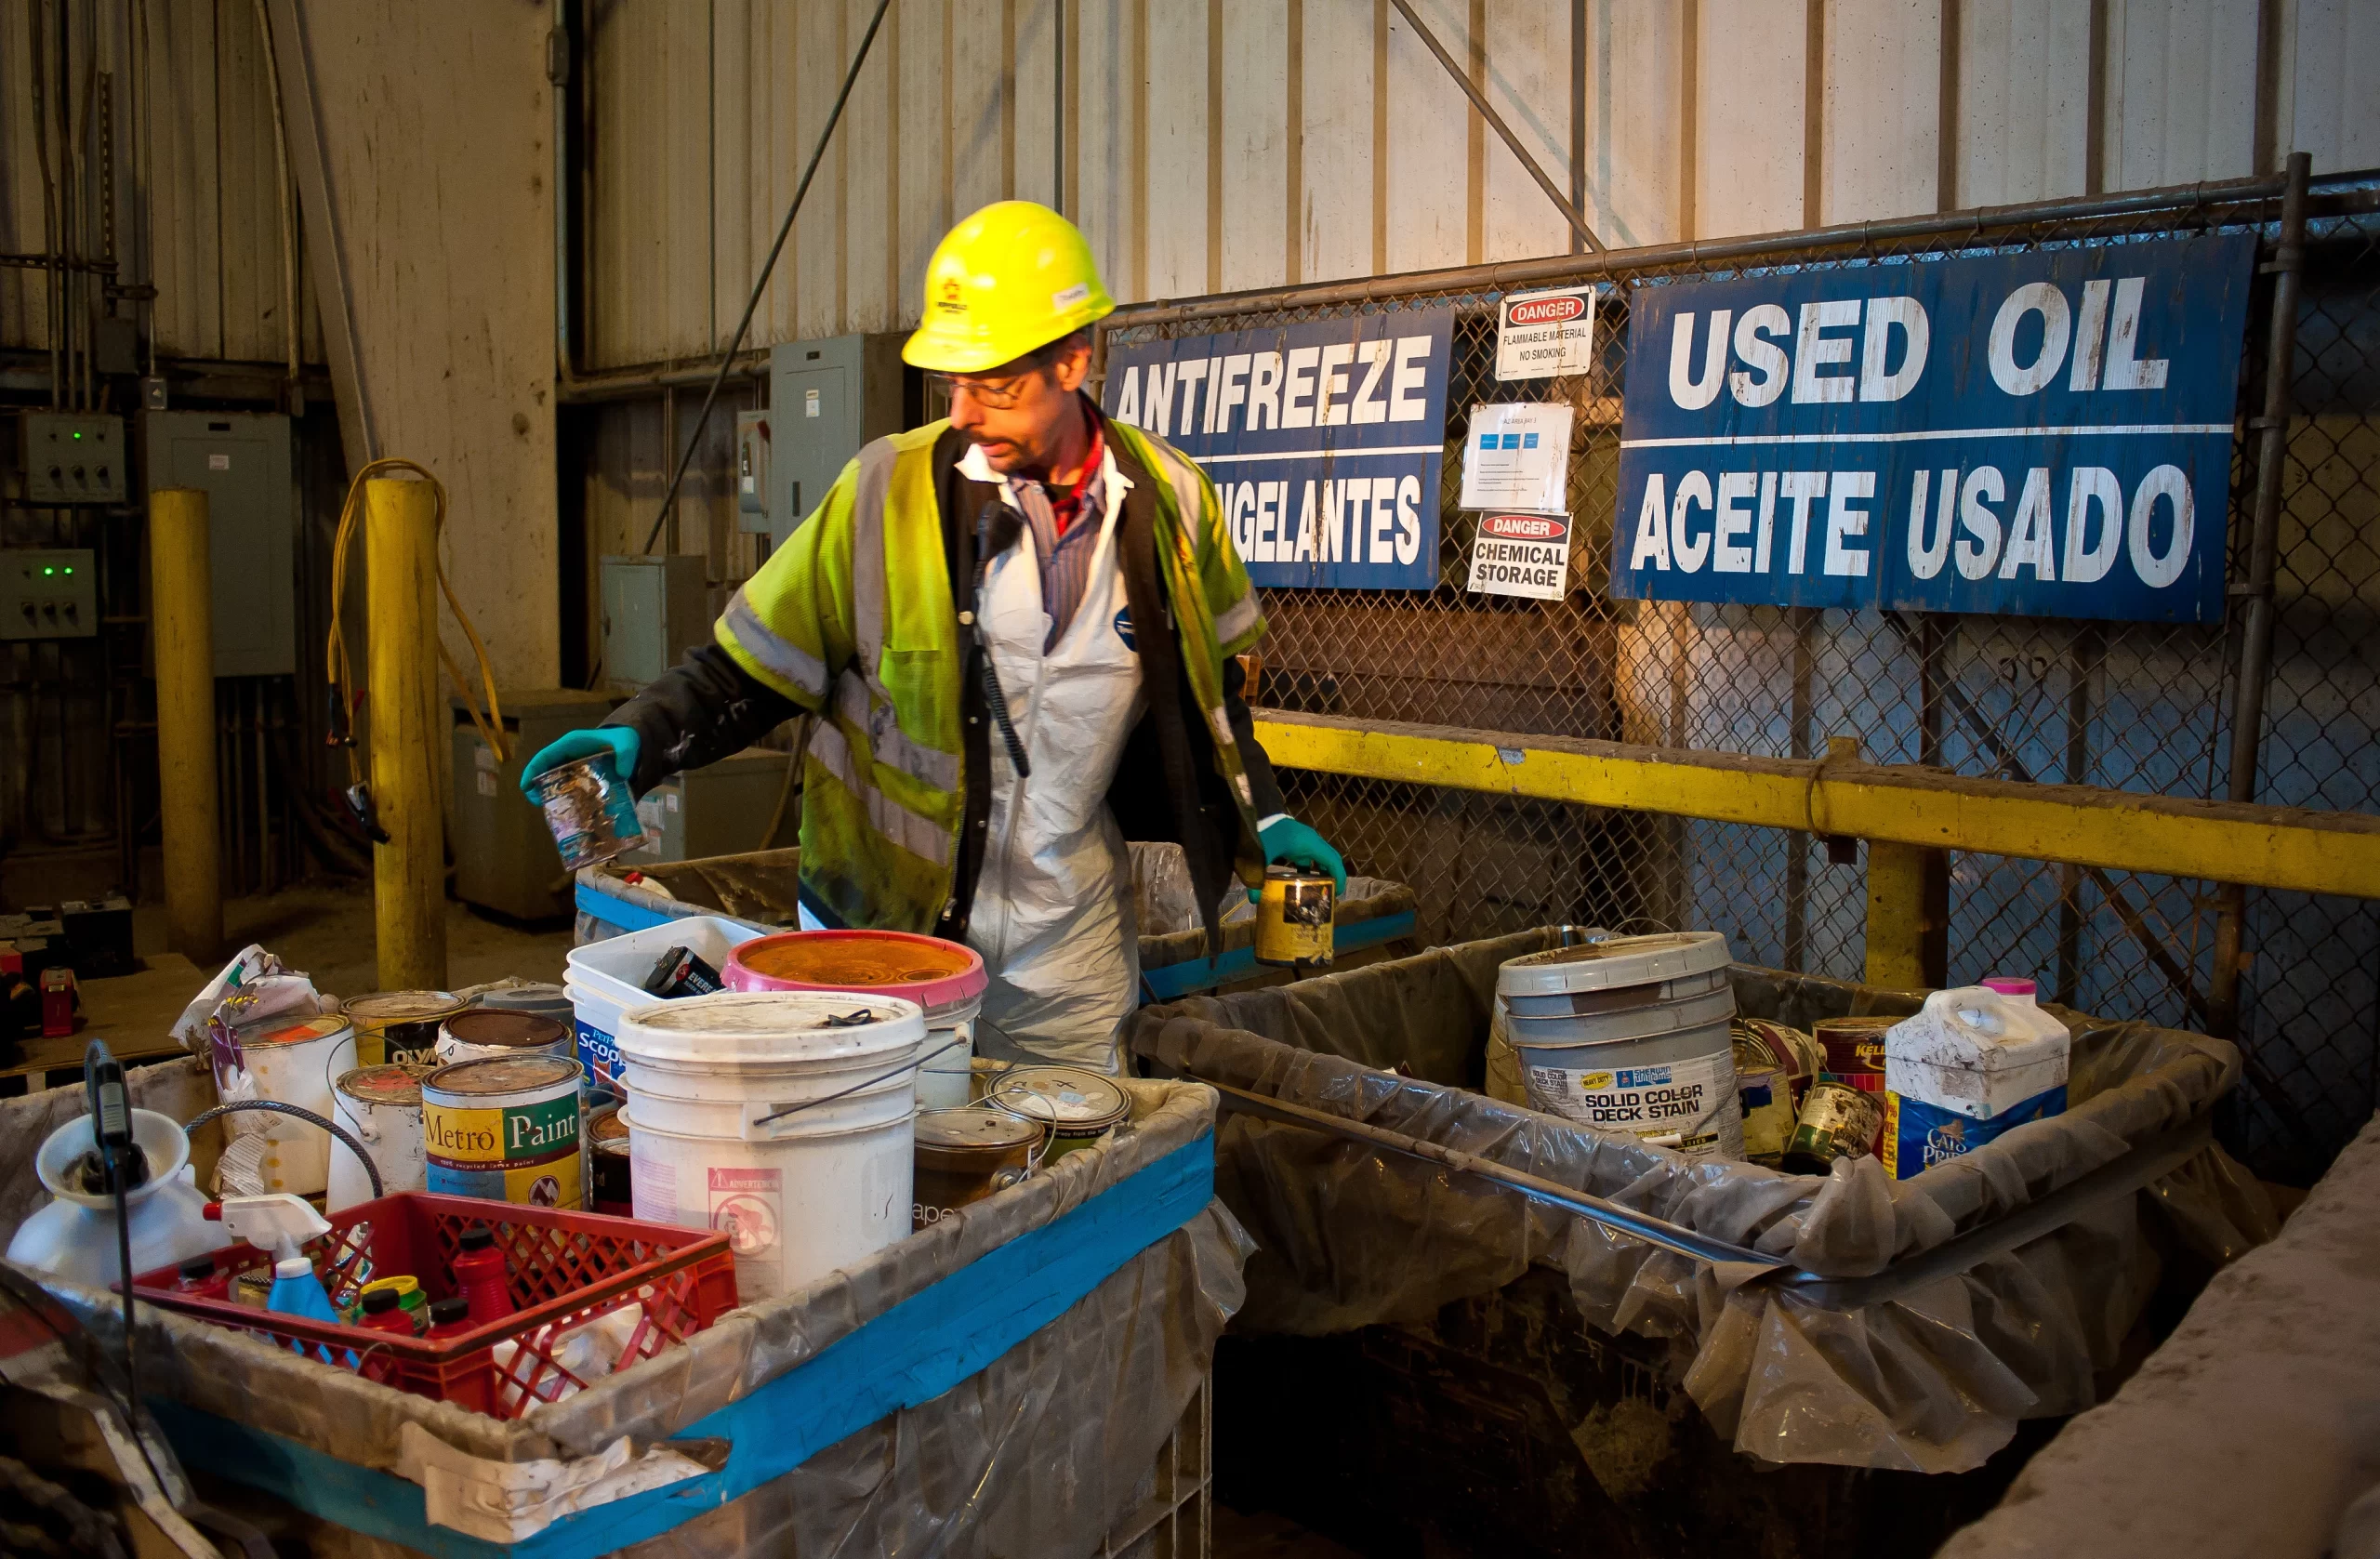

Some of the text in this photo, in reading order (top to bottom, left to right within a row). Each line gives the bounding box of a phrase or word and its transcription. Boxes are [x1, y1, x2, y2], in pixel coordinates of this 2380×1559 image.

[1517, 300, 1575, 321] DANGER
[1503, 327, 1586, 346] FLAMMABLE MATERIAL
[1669, 276, 2169, 410] USED OIL
[1519, 347, 1567, 361] NO SMOKING
[1116, 335, 1433, 437] ANTIFREEZE
[1493, 519, 1551, 536] DANGER
[1630, 464, 2195, 588] ACEITE USADO
[1475, 542, 1565, 566] CHEMICAL
[1475, 563, 1558, 588] STORAGE
[688, 971, 717, 993] EVERE
[1583, 1075, 1609, 1086] HEAVY DUTY
[1585, 1084, 1703, 1109] SOLID COLOR
[1593, 1099, 1700, 1122] DECK STAIN
[425, 1110, 575, 1151] Metro Paint
[514, 1158, 535, 1168] paint
